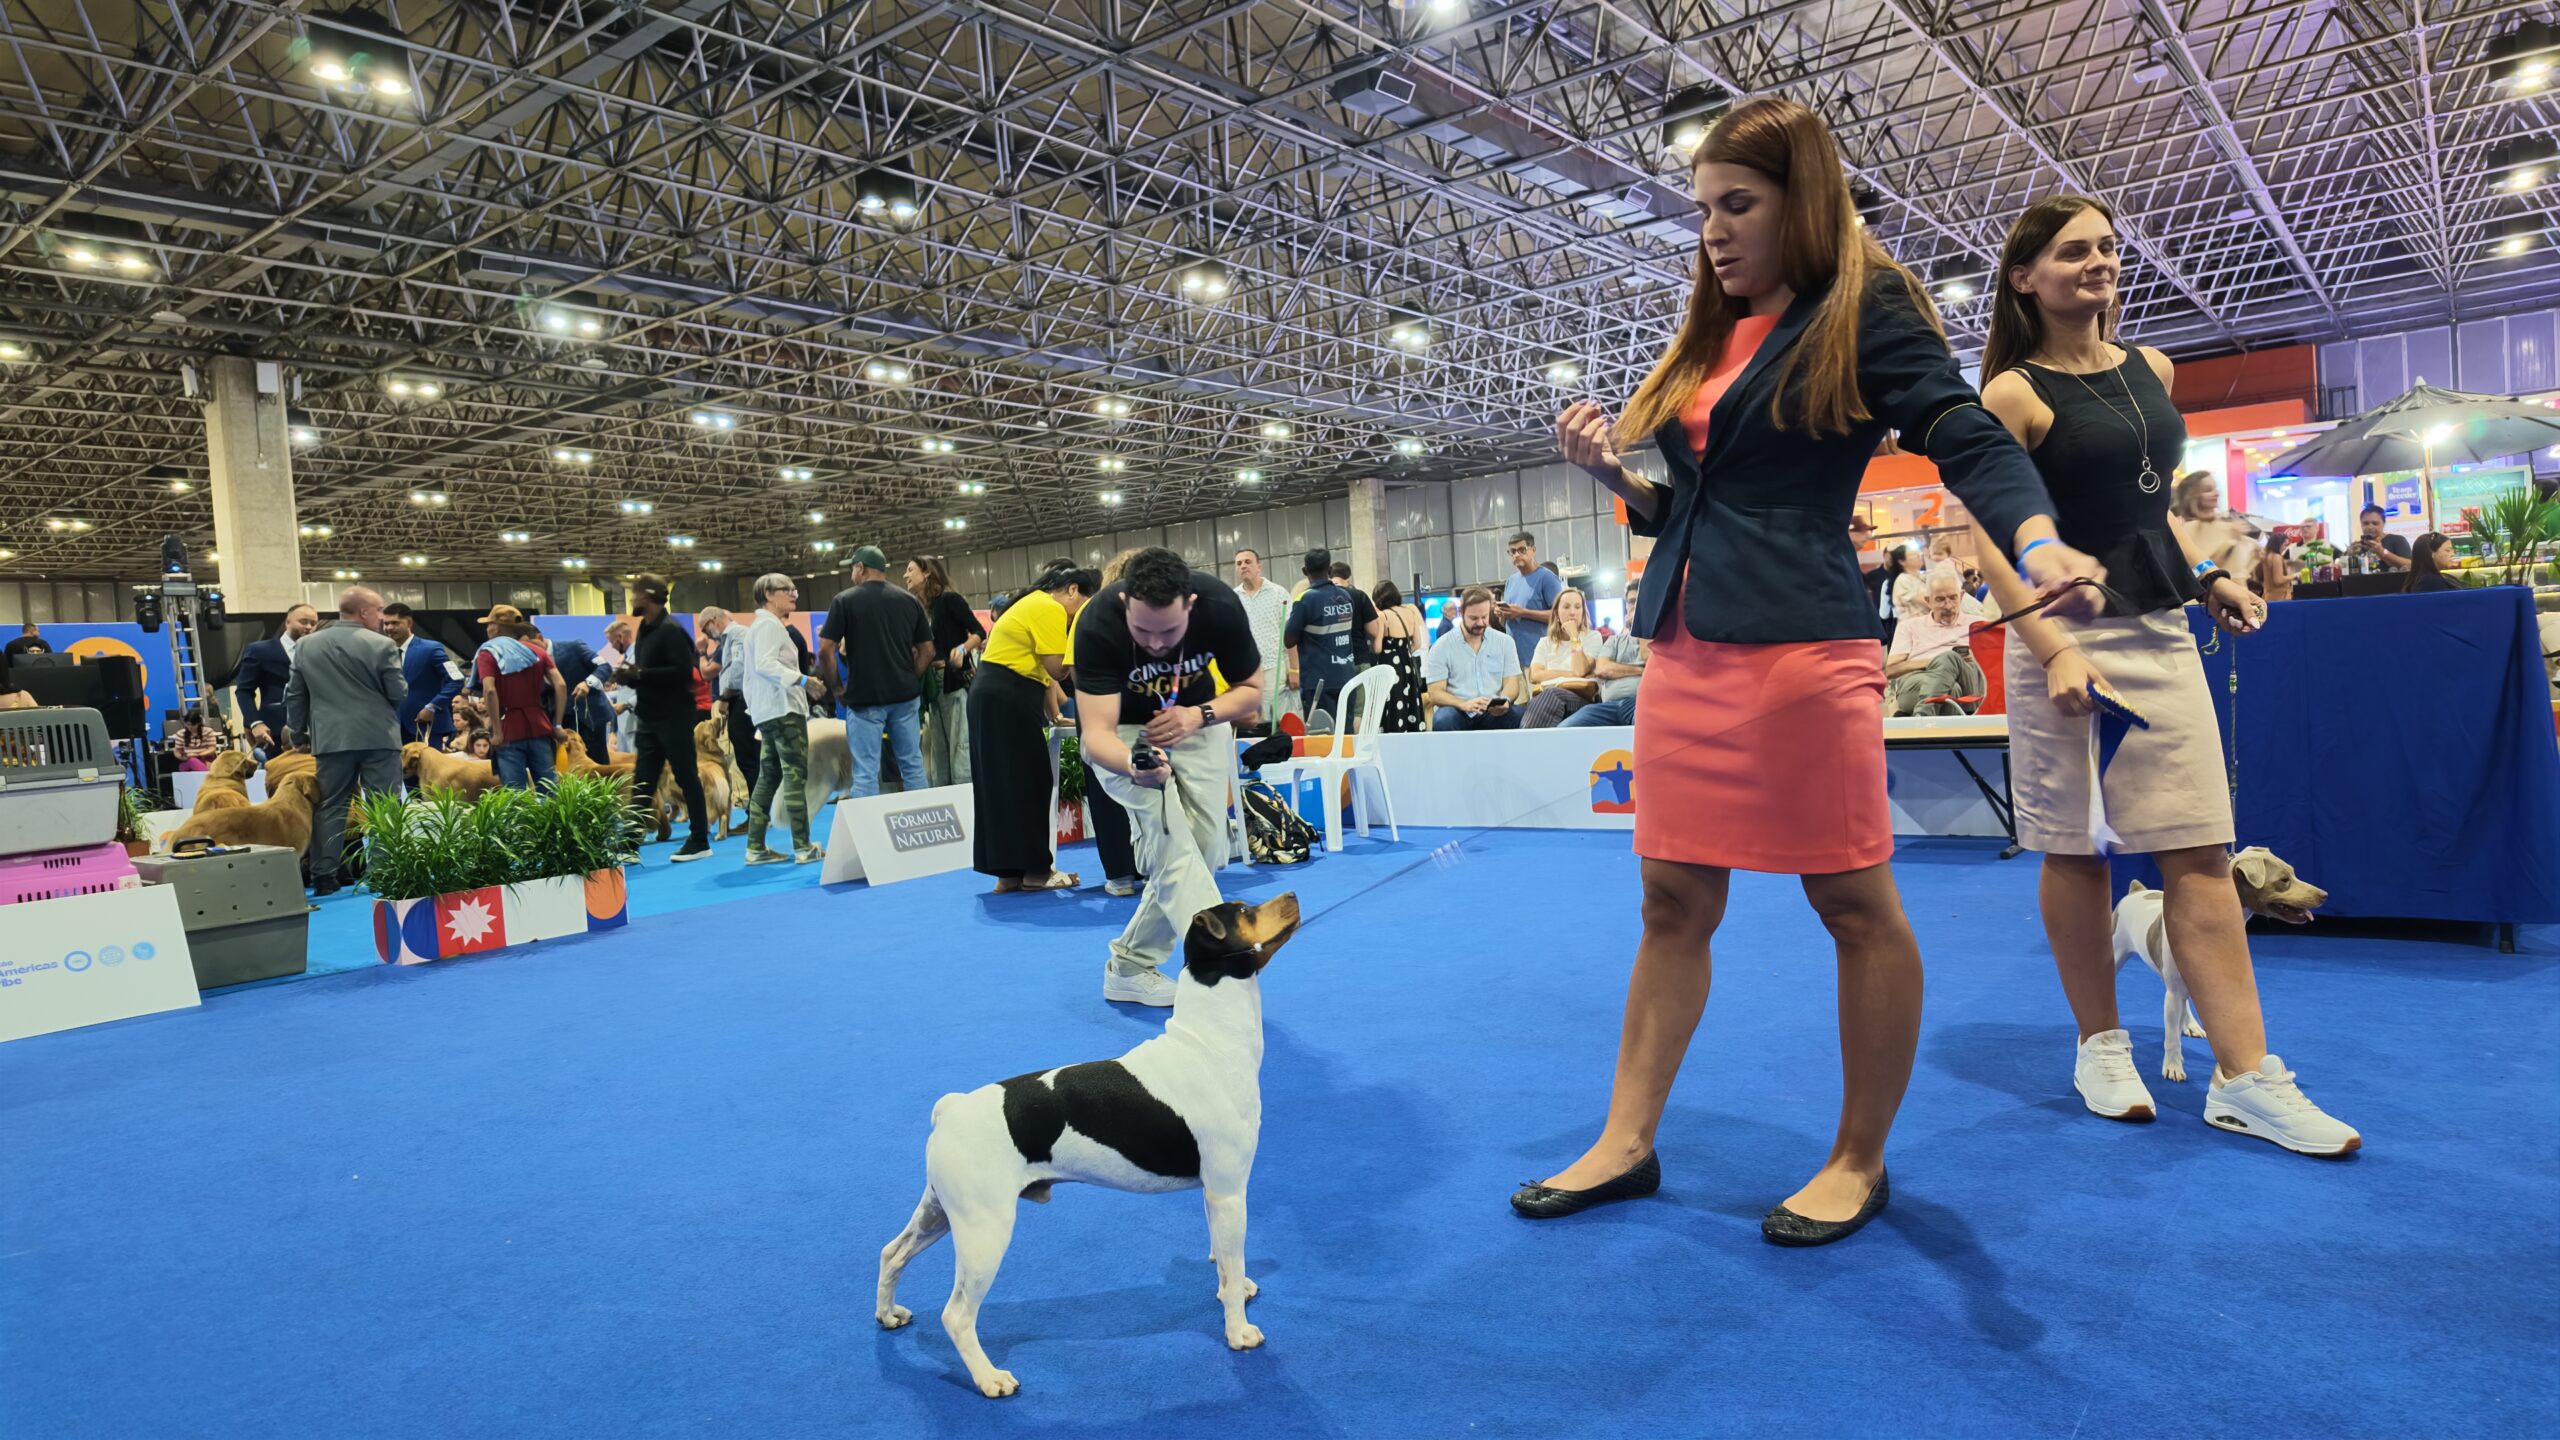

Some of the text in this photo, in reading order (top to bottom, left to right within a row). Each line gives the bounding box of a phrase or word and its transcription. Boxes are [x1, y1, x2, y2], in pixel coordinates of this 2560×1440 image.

[1916, 492, 1943, 525] 2
[889, 808, 954, 830] FÓRMULA
[895, 825, 961, 848] NATURAL
